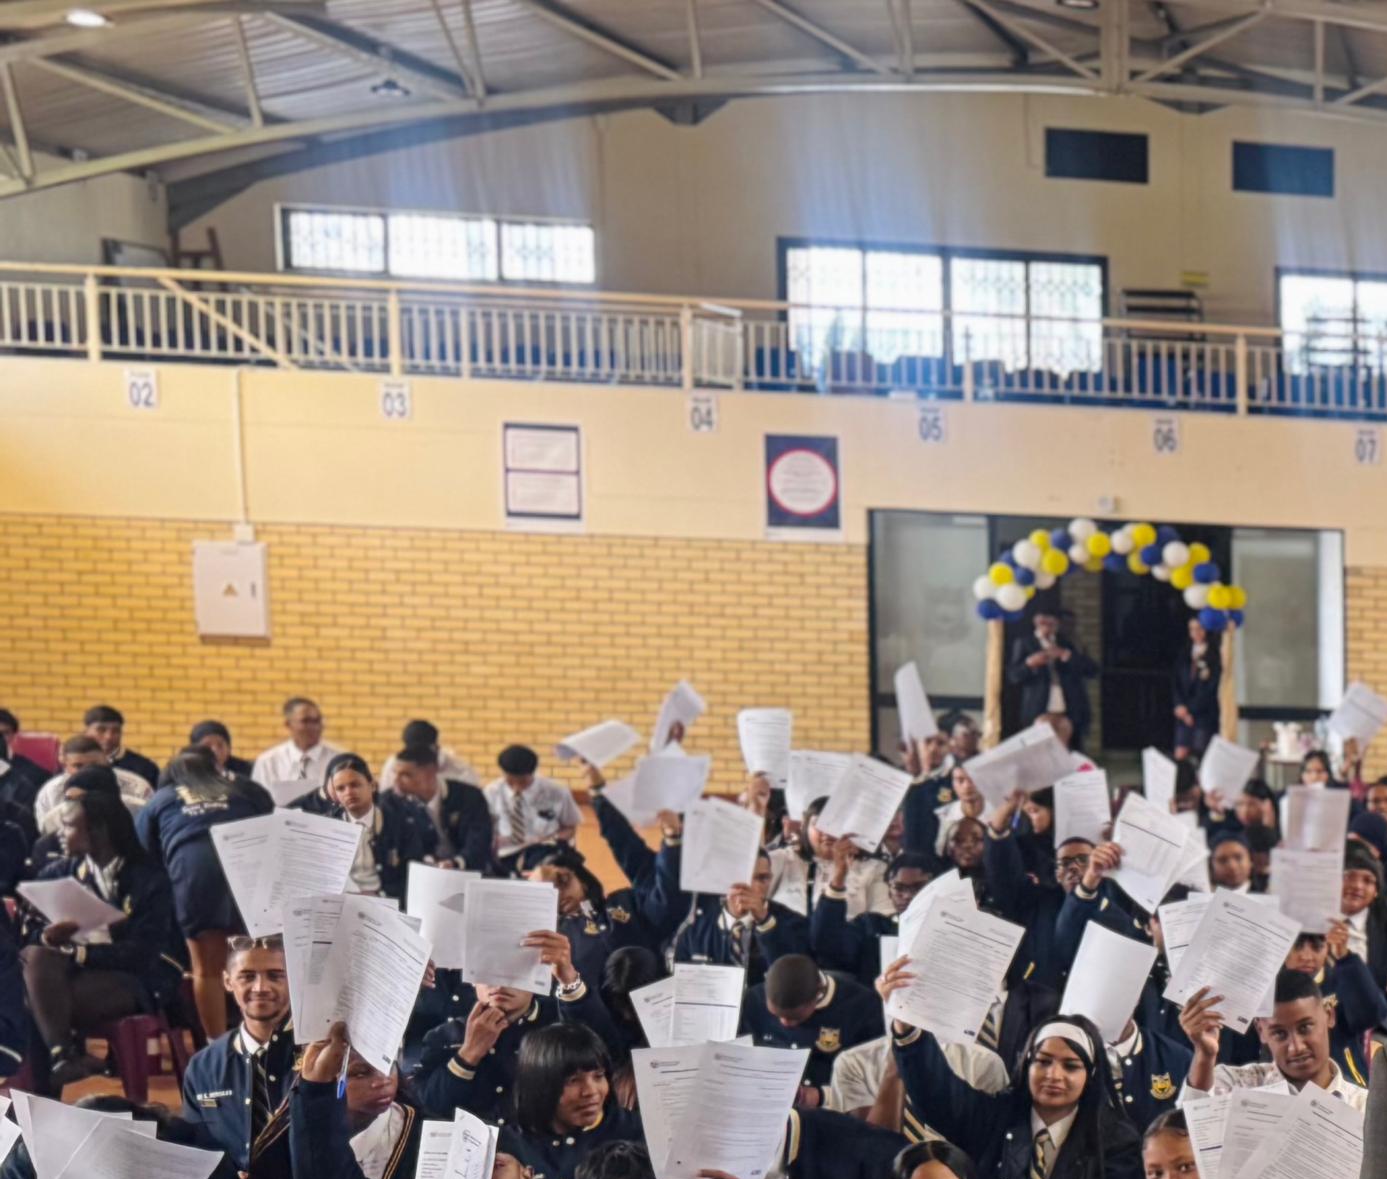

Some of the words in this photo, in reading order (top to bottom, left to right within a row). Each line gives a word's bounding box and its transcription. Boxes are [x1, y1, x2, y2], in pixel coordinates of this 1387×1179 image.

[129, 382, 154, 407] 02
[383, 391, 407, 417] 03
[690, 406, 713, 430] 04
[919, 416, 942, 441] 05
[1153, 428, 1177, 452] 06
[1355, 438, 1377, 462] 07
